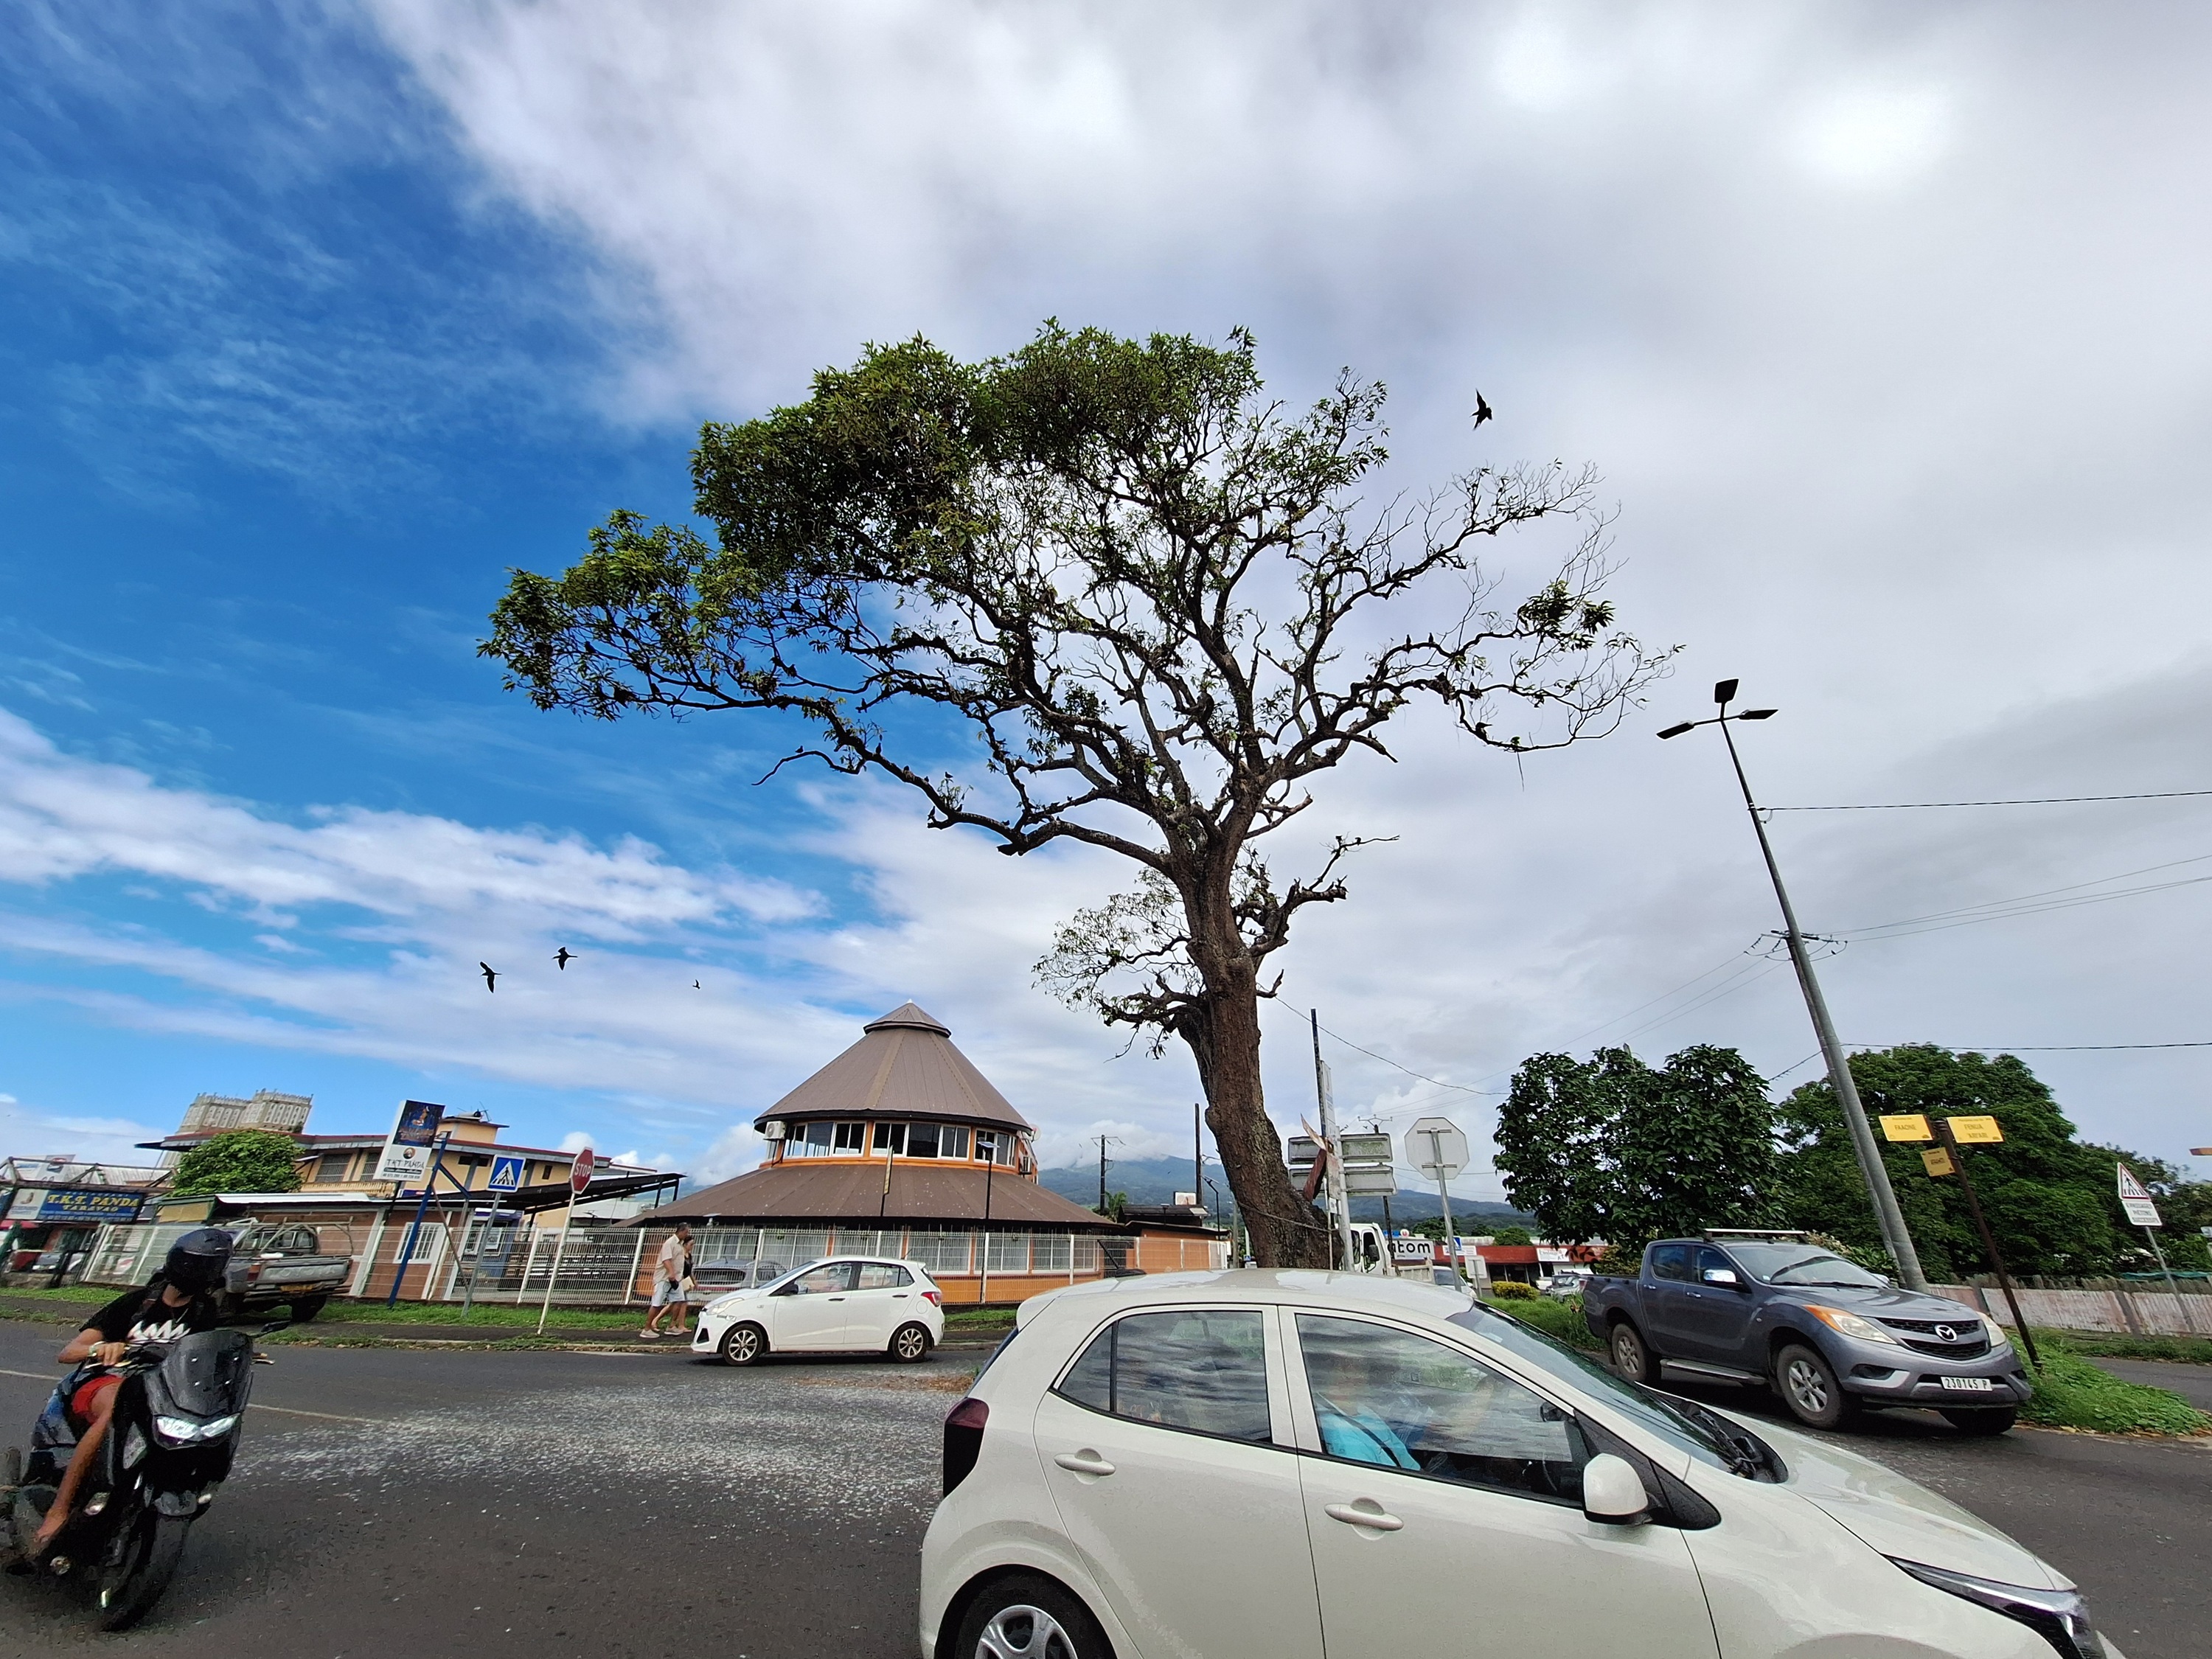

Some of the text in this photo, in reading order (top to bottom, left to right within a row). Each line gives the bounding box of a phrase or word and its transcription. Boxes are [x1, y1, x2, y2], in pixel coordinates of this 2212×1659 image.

[574, 1163, 591, 1178] STOP
[90, 1197, 140, 1207] PANDA
[1945, 1377, 1987, 1389] 230145 P
